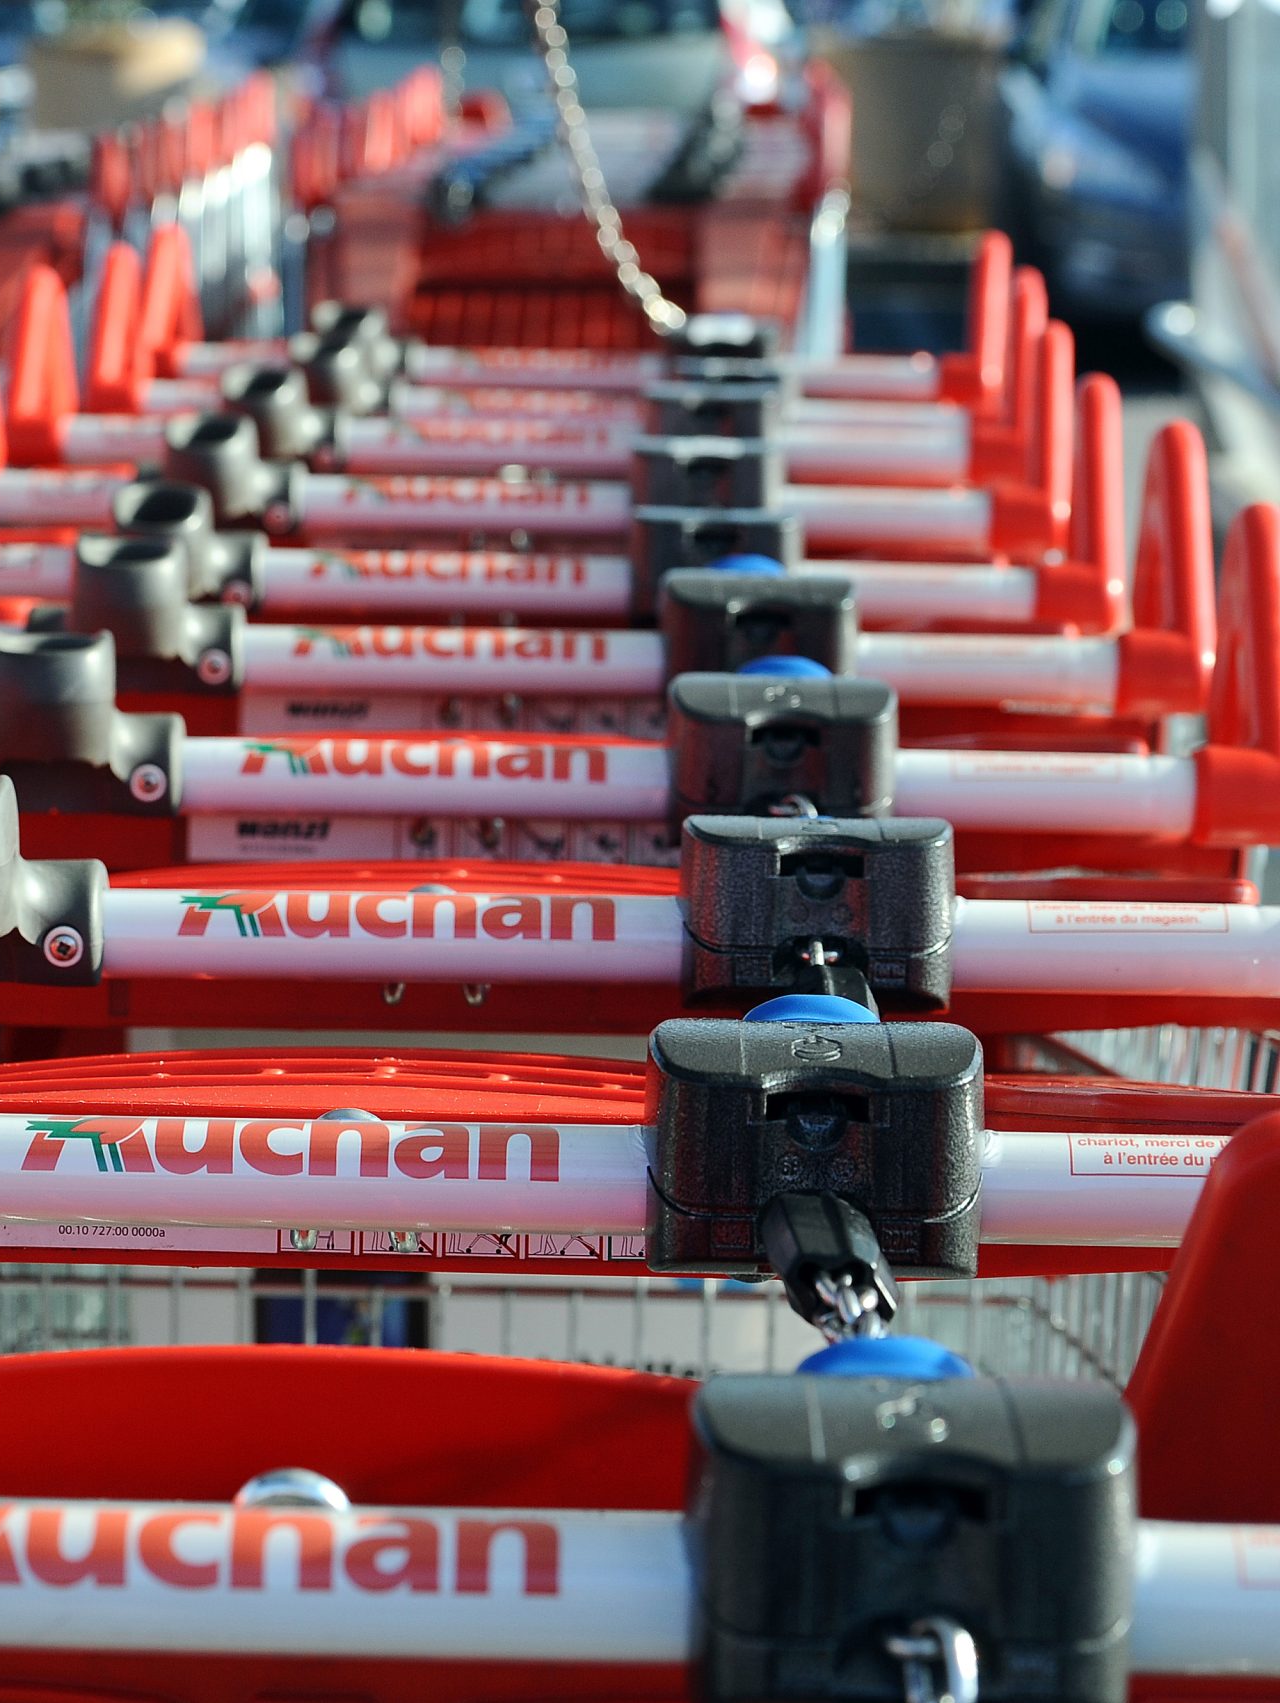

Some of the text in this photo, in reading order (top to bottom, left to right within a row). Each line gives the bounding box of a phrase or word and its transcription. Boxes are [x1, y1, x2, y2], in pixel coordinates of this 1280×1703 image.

[240, 740, 607, 783] Auchan
[178, 892, 616, 941] Auchan
[1121, 914, 1138, 924] du
[21, 1116, 559, 1182] Auchan
[1077, 1137, 1140, 1148] chariot,
[1145, 1138, 1190, 1148] merci
[1195, 1138, 1215, 1148] de
[1103, 1152, 1113, 1165] à
[1118, 1152, 1179, 1166] l'entrée
[1183, 1153, 1204, 1166] du
[58, 1225, 166, 1237] 00.10 727:00 0000a
